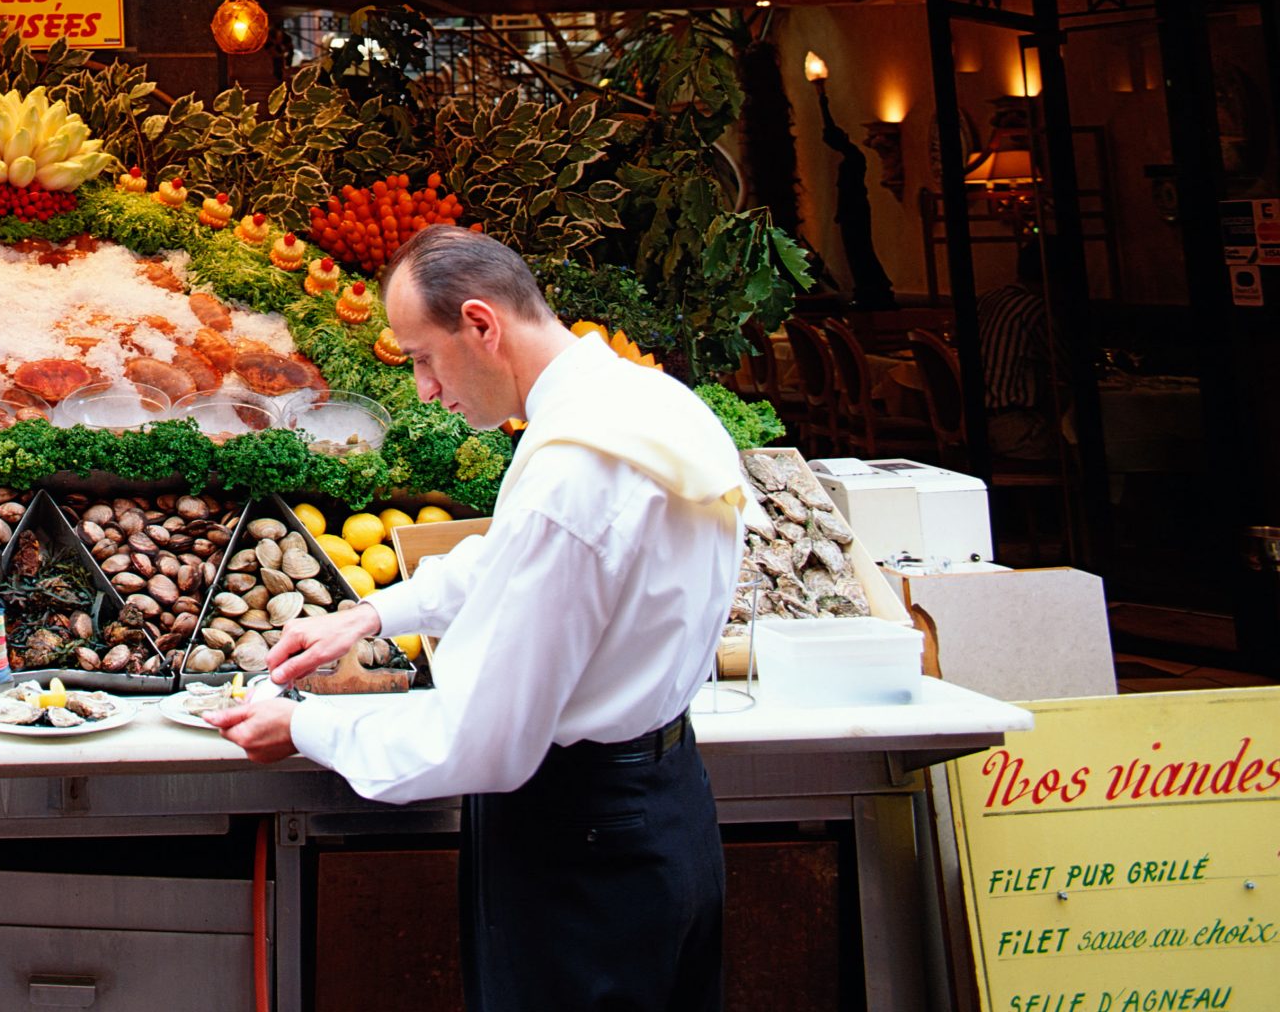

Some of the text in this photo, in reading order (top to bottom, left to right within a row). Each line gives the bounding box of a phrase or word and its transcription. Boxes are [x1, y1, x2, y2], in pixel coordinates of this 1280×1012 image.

[981, 737, 1280, 808] Nos viandes
[1065, 863, 1115, 888] PUR
[1077, 929, 1148, 951] sauce
[1150, 927, 1189, 948] au
[1192, 917, 1279, 945] choix
[1096, 987, 1233, 1012] D'AGNEAU
